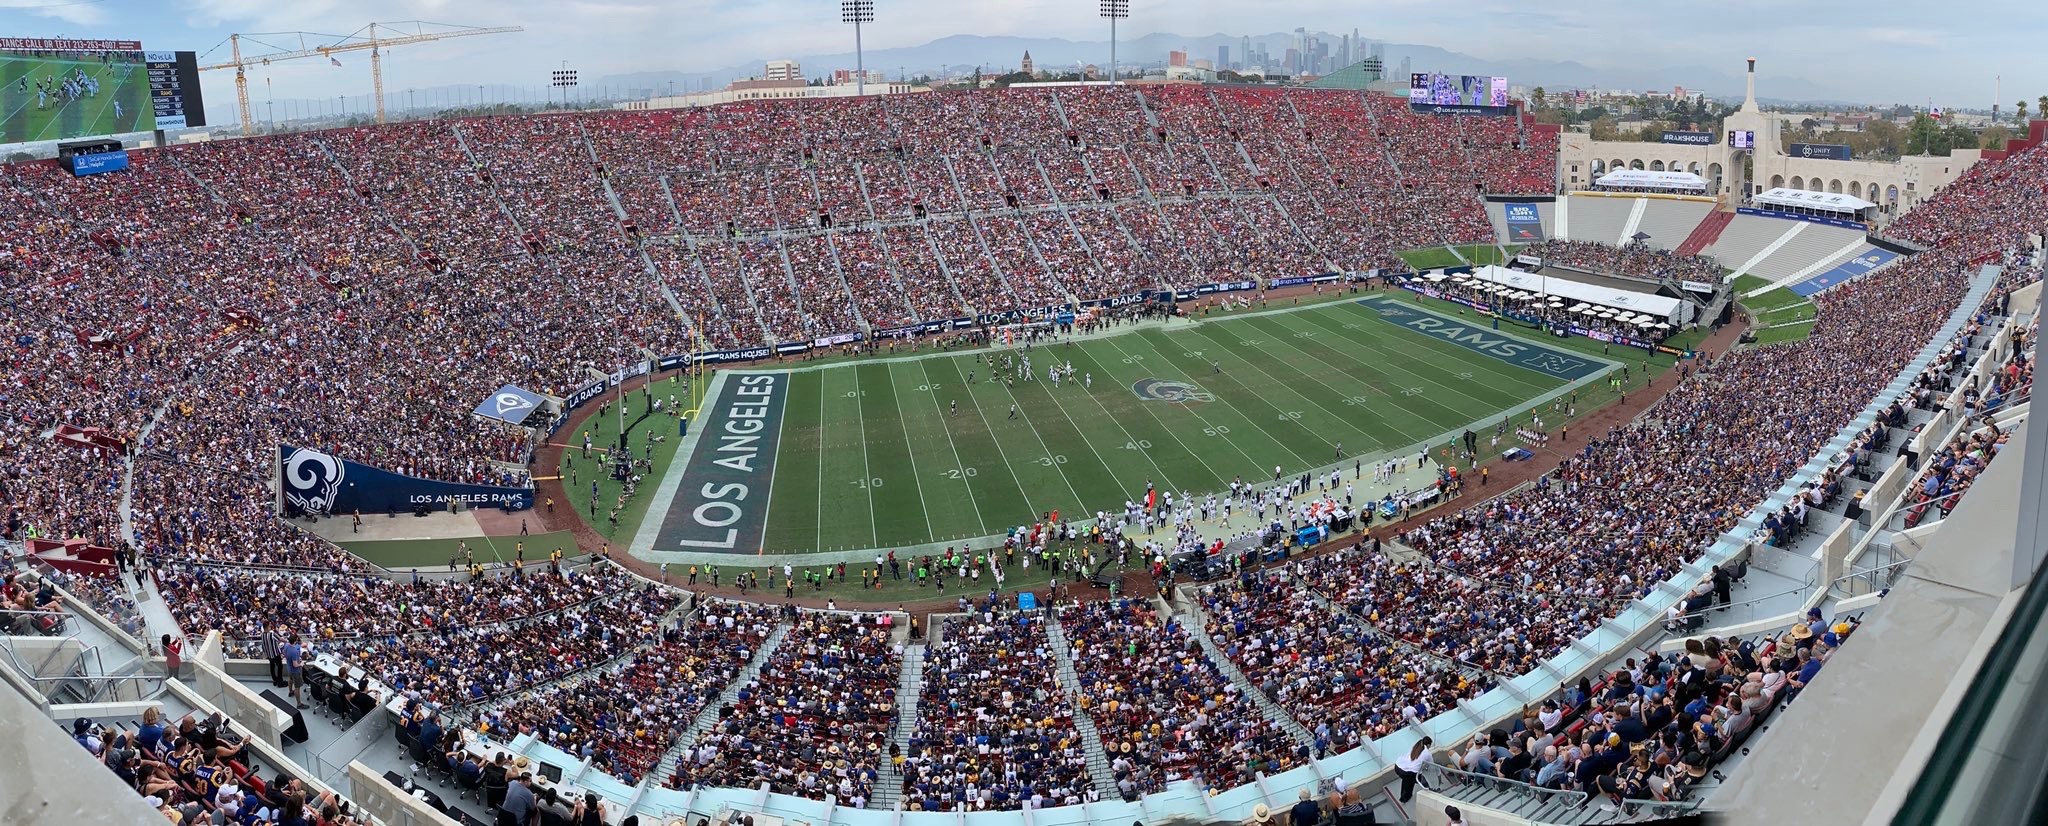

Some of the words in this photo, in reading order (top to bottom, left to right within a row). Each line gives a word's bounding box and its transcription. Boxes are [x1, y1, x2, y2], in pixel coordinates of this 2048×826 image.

[26, 39, 43, 48] CALL
[44, 39, 53, 48] OR
[55, 40, 71, 49] TEXT
[1664, 134, 1710, 143] #RAMSHOUSE
[1111, 294, 1142, 307] RAMS
[1406, 317, 1528, 357] RAMS
[719, 352, 740, 360] RAMS
[569, 398, 579, 408] LA
[580, 383, 603, 401] RAMS
[712, 375, 775, 472] ANGELES
[1203, 425, 1230, 437] 50
[1125, 439, 1152, 450] 40
[1039, 454, 1068, 467] 30
[948, 467, 978, 479] 20
[859, 477, 883, 489] 10
[410, 494, 432, 503] LOS
[491, 493, 522, 502] RAMS
[680, 482, 749, 548] LOS
